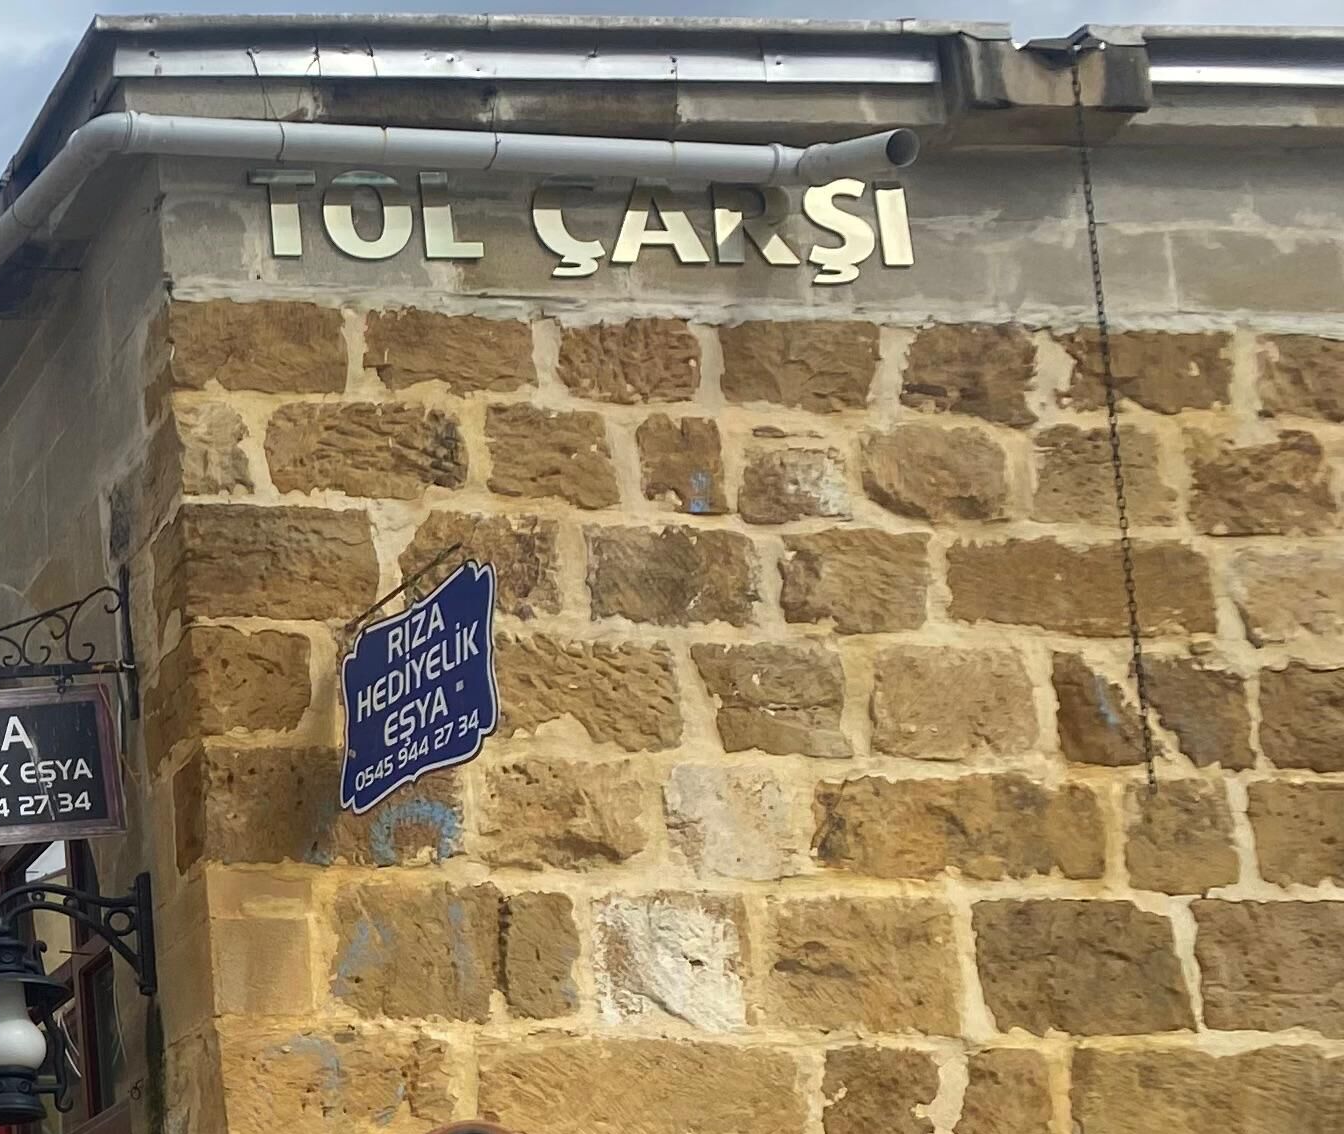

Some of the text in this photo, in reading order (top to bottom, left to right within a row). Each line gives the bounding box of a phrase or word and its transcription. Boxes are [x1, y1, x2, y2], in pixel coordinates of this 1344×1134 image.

[248, 170, 916, 285] TOL ÇARŞI
[386, 602, 446, 661] RIZA
[356, 620, 480, 724] HEDİYELİK
[383, 693, 449, 747] EŞYA
[20, 758, 93, 789] EŞYA
[356, 708, 480, 793] 0545 944 27 34
[18, 794, 50, 816] 27
[57, 791, 92, 813] 34
